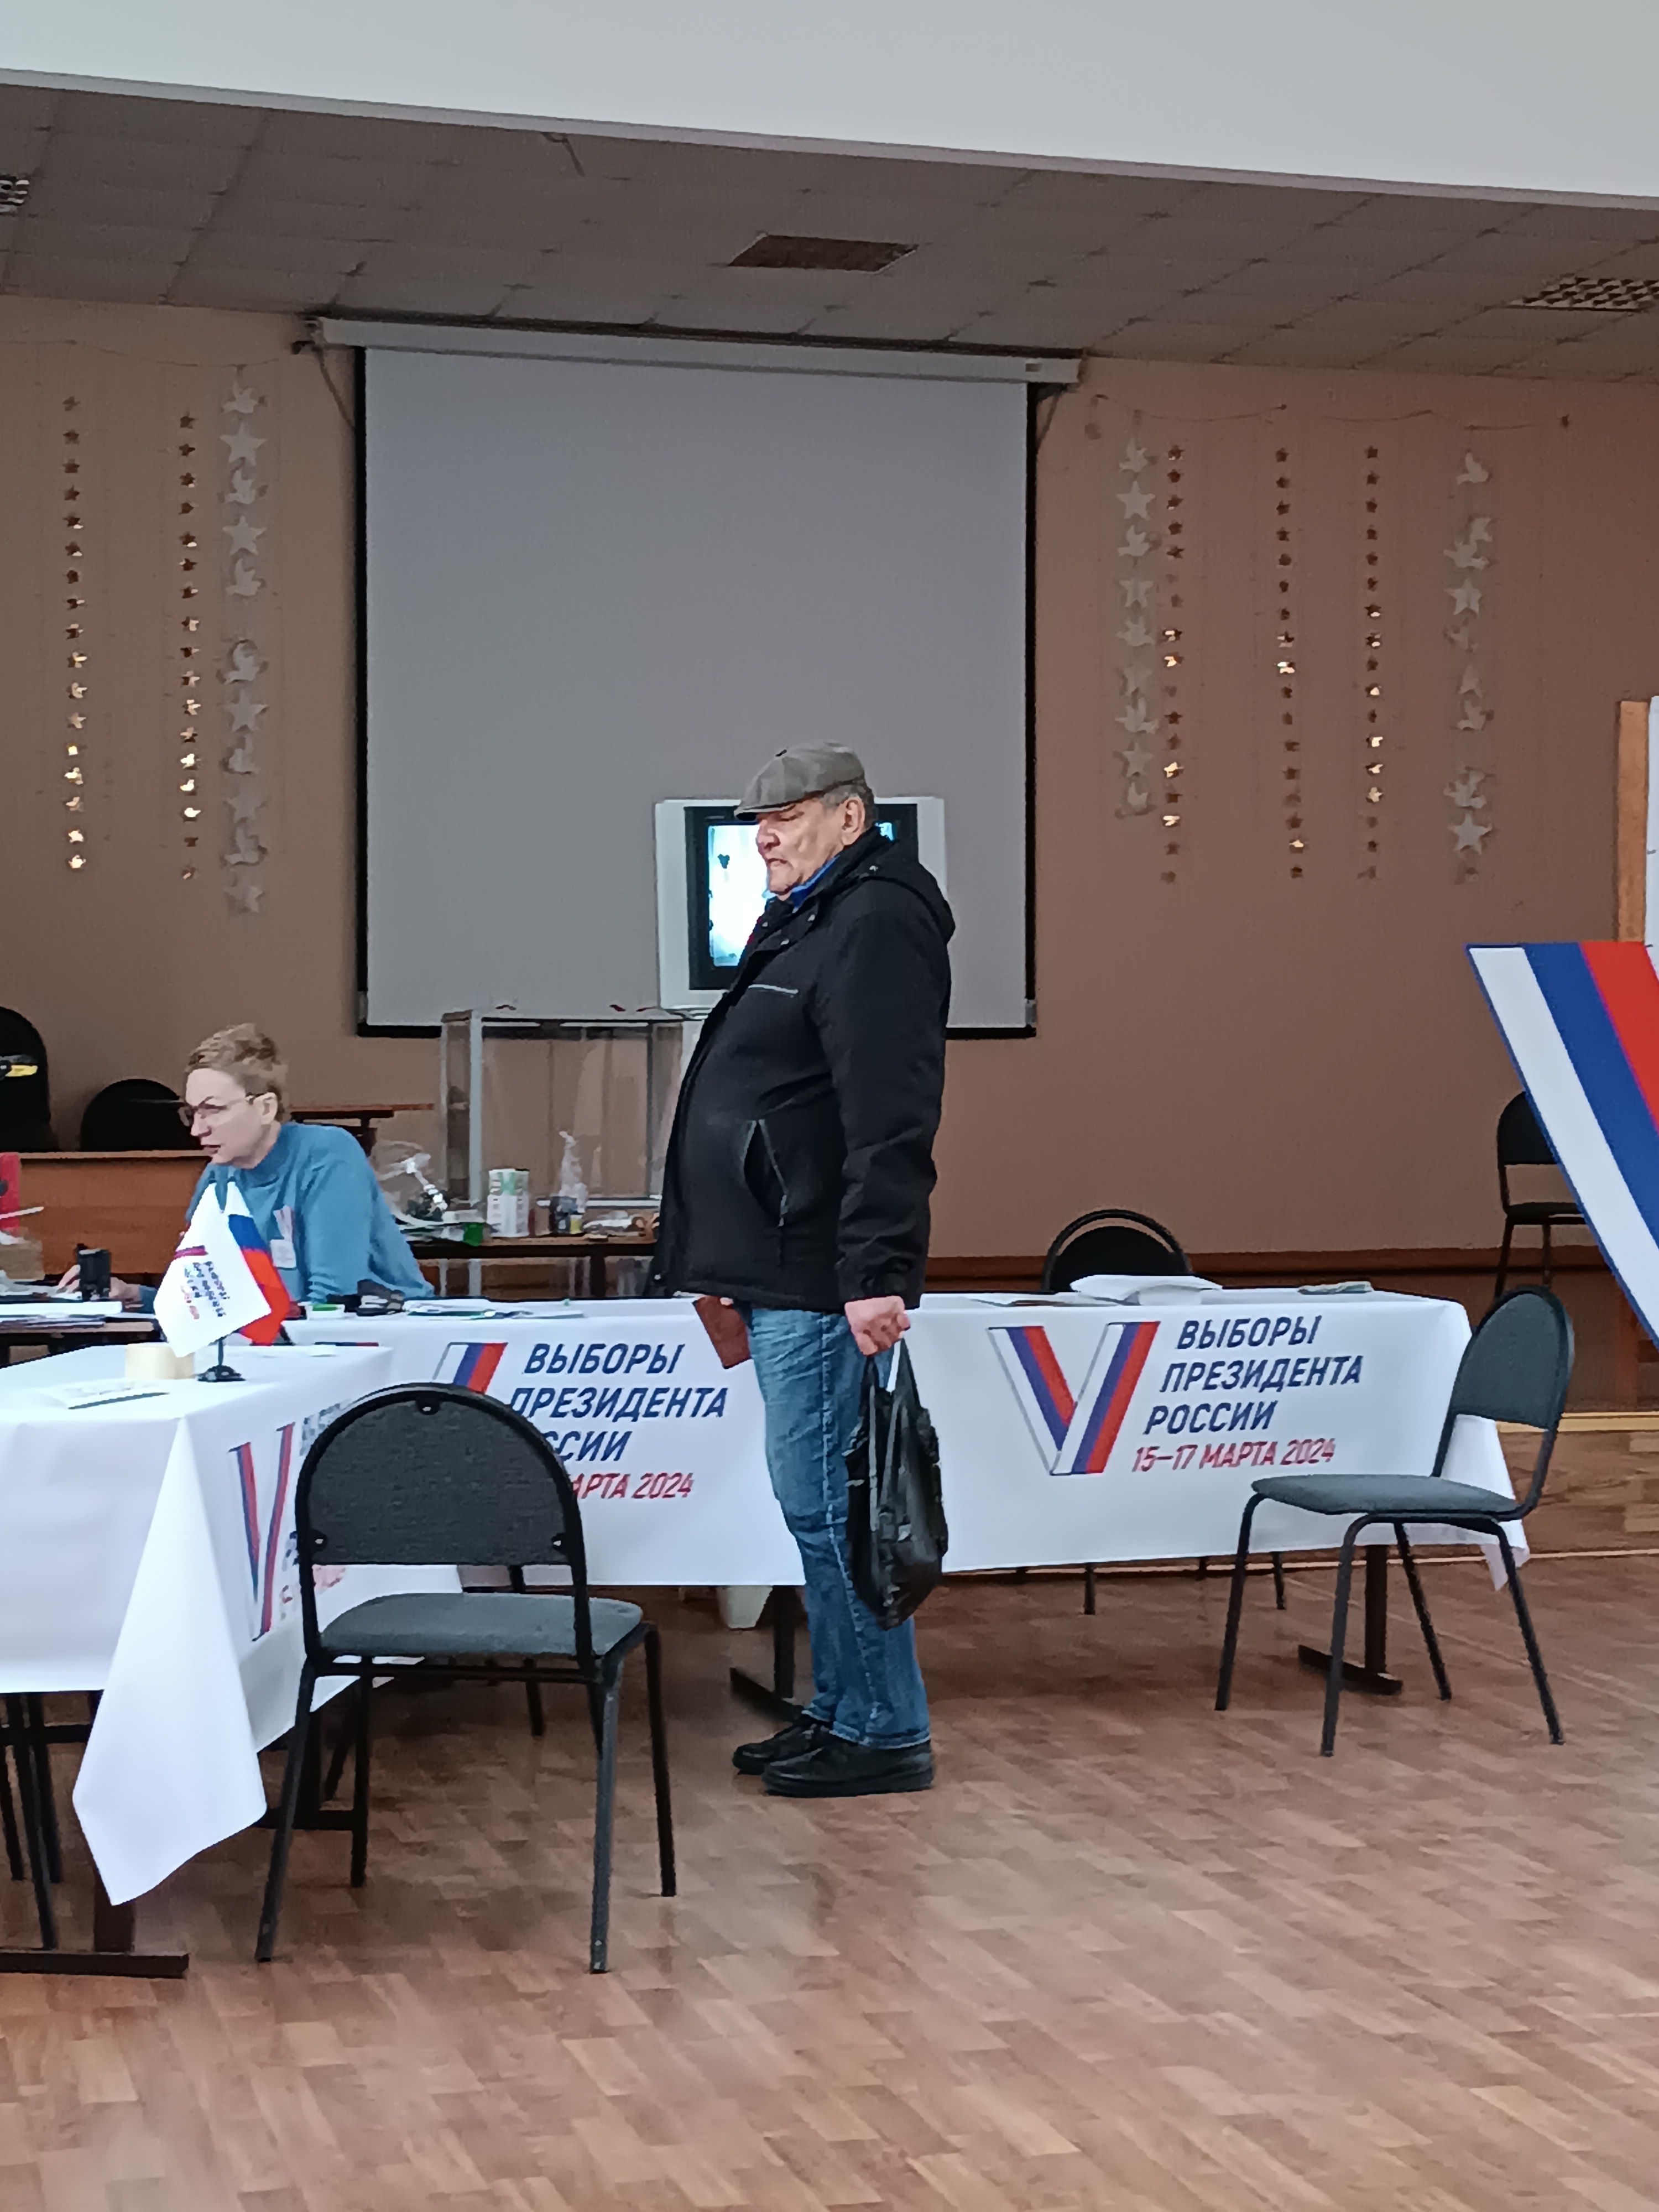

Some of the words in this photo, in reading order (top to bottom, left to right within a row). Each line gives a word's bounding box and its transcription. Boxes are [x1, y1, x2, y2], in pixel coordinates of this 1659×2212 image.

[1175, 1315, 1322, 1349] ВЫБОРЫ
[523, 1343, 686, 1374] ВЫБОРЫ
[1159, 1355, 1364, 1393] ПРЕЗИДЕНТА
[510, 1387, 729, 1423] ПРЕЗИДЕНТА
[1142, 1400, 1279, 1435] РОССИИ
[1198, 1441, 1277, 1470] МАРТА
[1280, 1438, 1335, 1467] 2024
[568, 1473, 631, 1500] АРТА
[631, 1472, 695, 1499] 2024
